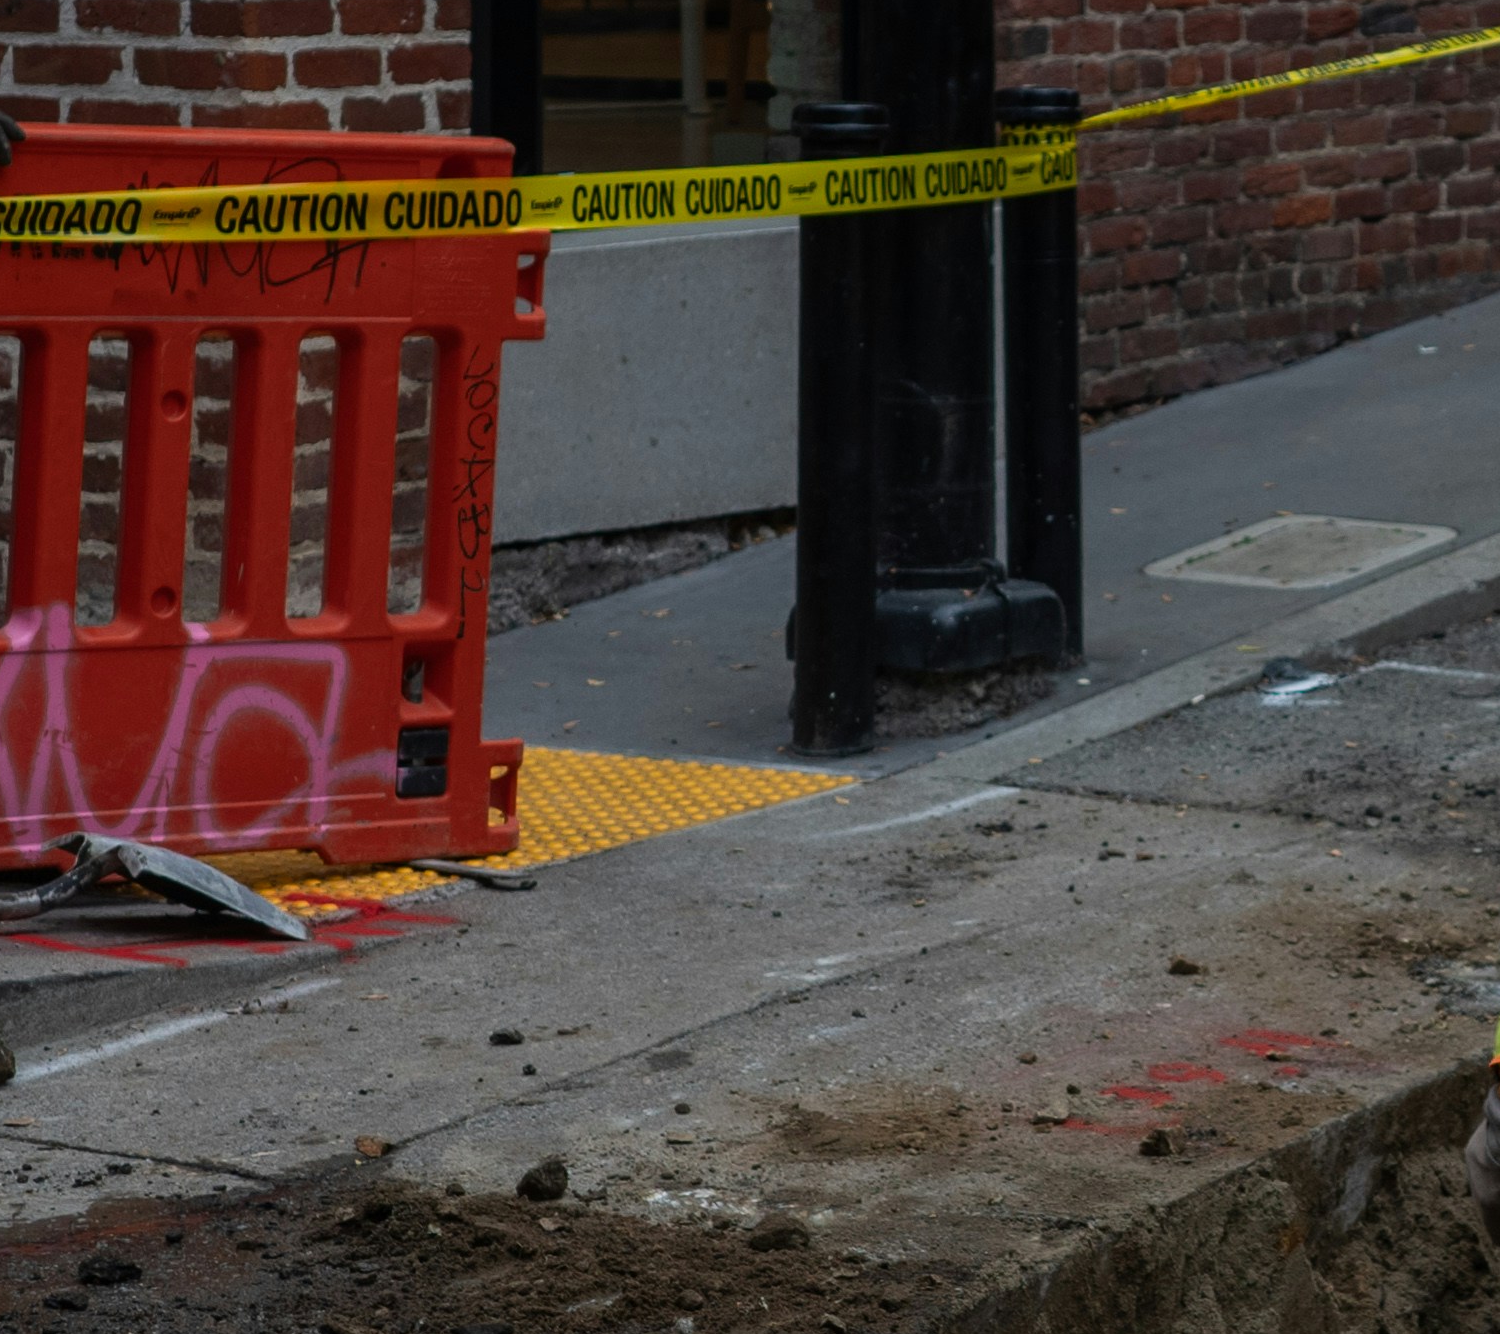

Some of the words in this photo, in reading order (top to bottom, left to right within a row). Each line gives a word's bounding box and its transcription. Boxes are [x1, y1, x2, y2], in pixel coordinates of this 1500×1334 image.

[215, 193, 369, 233] CAUTION
[384, 188, 522, 230] CUIDADO
[572, 181, 676, 223] CAUTION
[685, 174, 782, 217] CUIDADO
[825, 166, 917, 207] CAUTION
[924, 156, 1007, 198] CUIDADO
